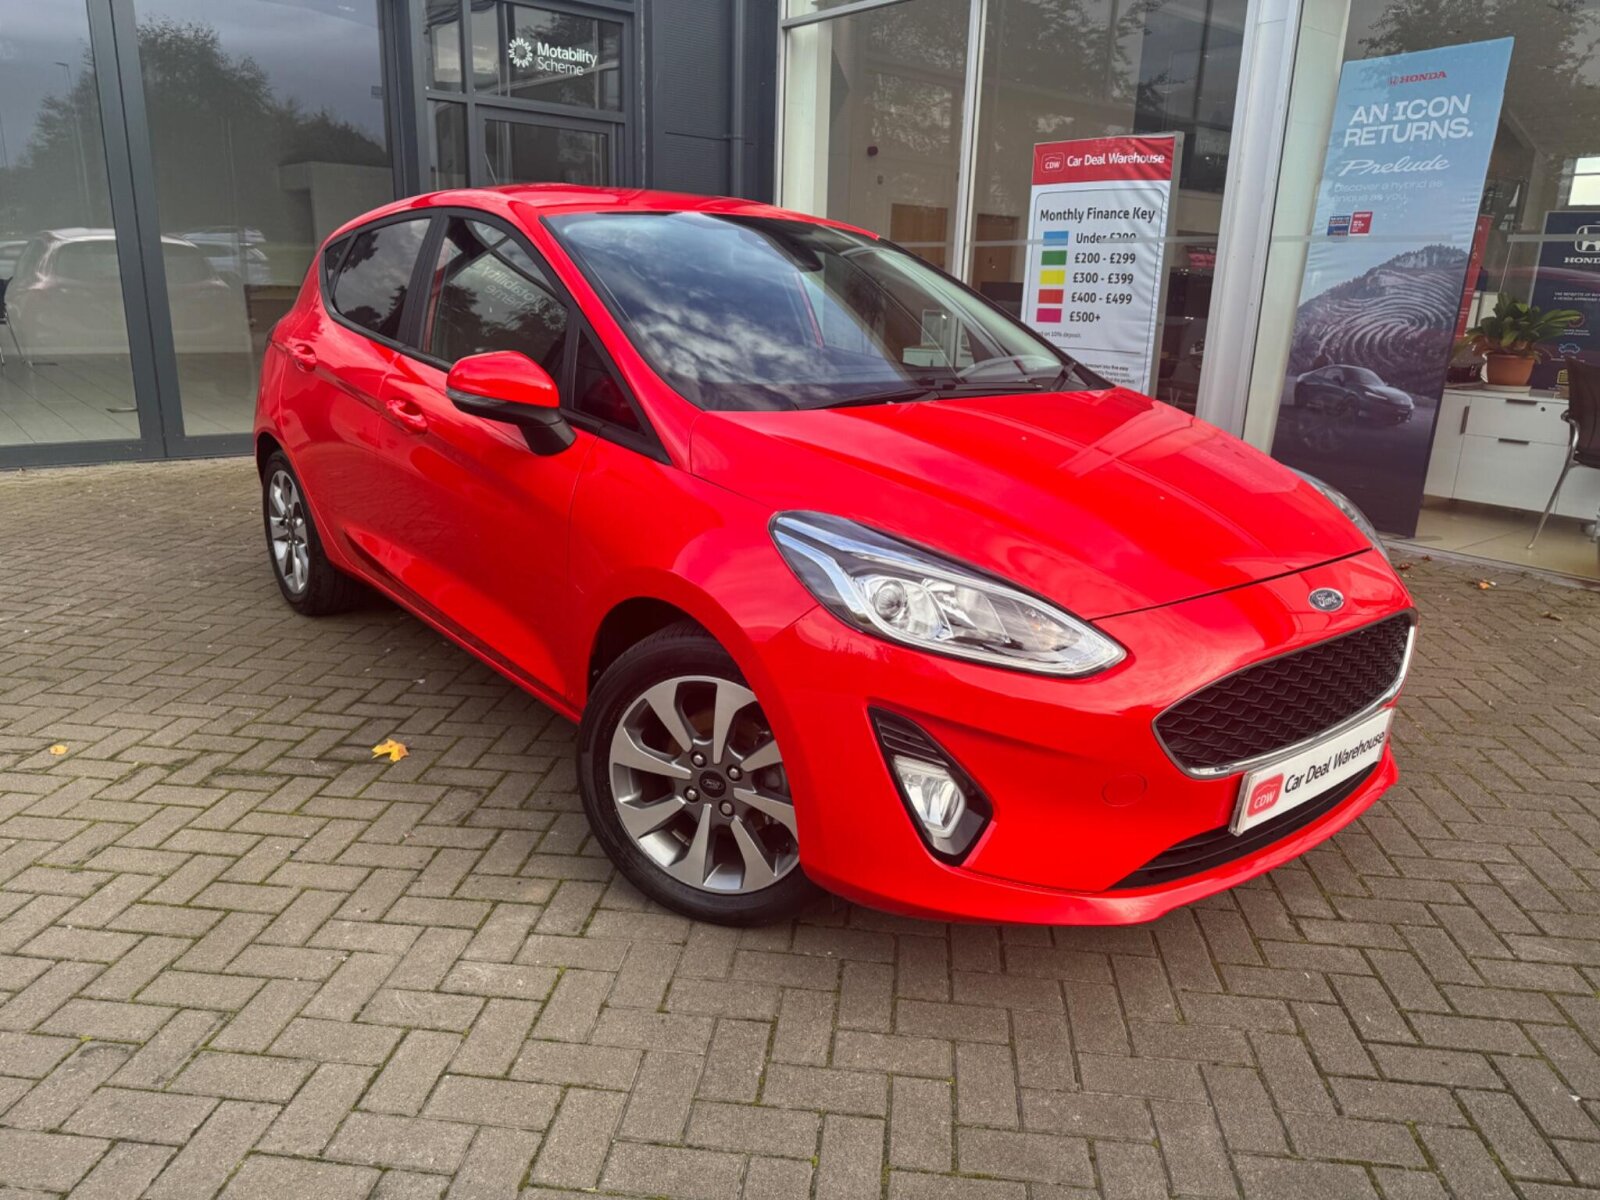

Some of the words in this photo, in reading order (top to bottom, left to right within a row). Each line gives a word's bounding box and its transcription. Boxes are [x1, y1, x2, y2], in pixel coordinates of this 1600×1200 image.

[537, 42, 597, 68] Motability
[537, 56, 584, 76] Scheme
[1399, 70, 1447, 84] HONDA
[1350, 103, 1388, 125] AN
[1392, 93, 1471, 120] ICON
[1343, 117, 1474, 147] RETURNS.
[1045, 161, 1060, 169] CDW
[1067, 156, 1083, 167] Car
[1084, 153, 1106, 166] Deal
[1108, 152, 1165, 163] Warehouse
[1337, 153, 1450, 177] Prelude
[1040, 208, 1084, 223] Monthly
[1087, 206, 1130, 220] Finance
[1132, 206, 1156, 223] Key
[1076, 232, 1107, 244] Under
[1074, 252, 1101, 264] £200
[1109, 252, 1137, 264] £299
[1072, 272, 1099, 284] £300
[1107, 272, 1134, 285] £399
[1071, 292, 1097, 304] £400
[1105, 292, 1133, 305] £499
[1069, 310, 1101, 323] £500+
[1253, 790, 1277, 809] CDW
[1284, 773, 1306, 793] Car
[1305, 756, 1332, 784] Deal
[1333, 731, 1385, 769] Warehouse
